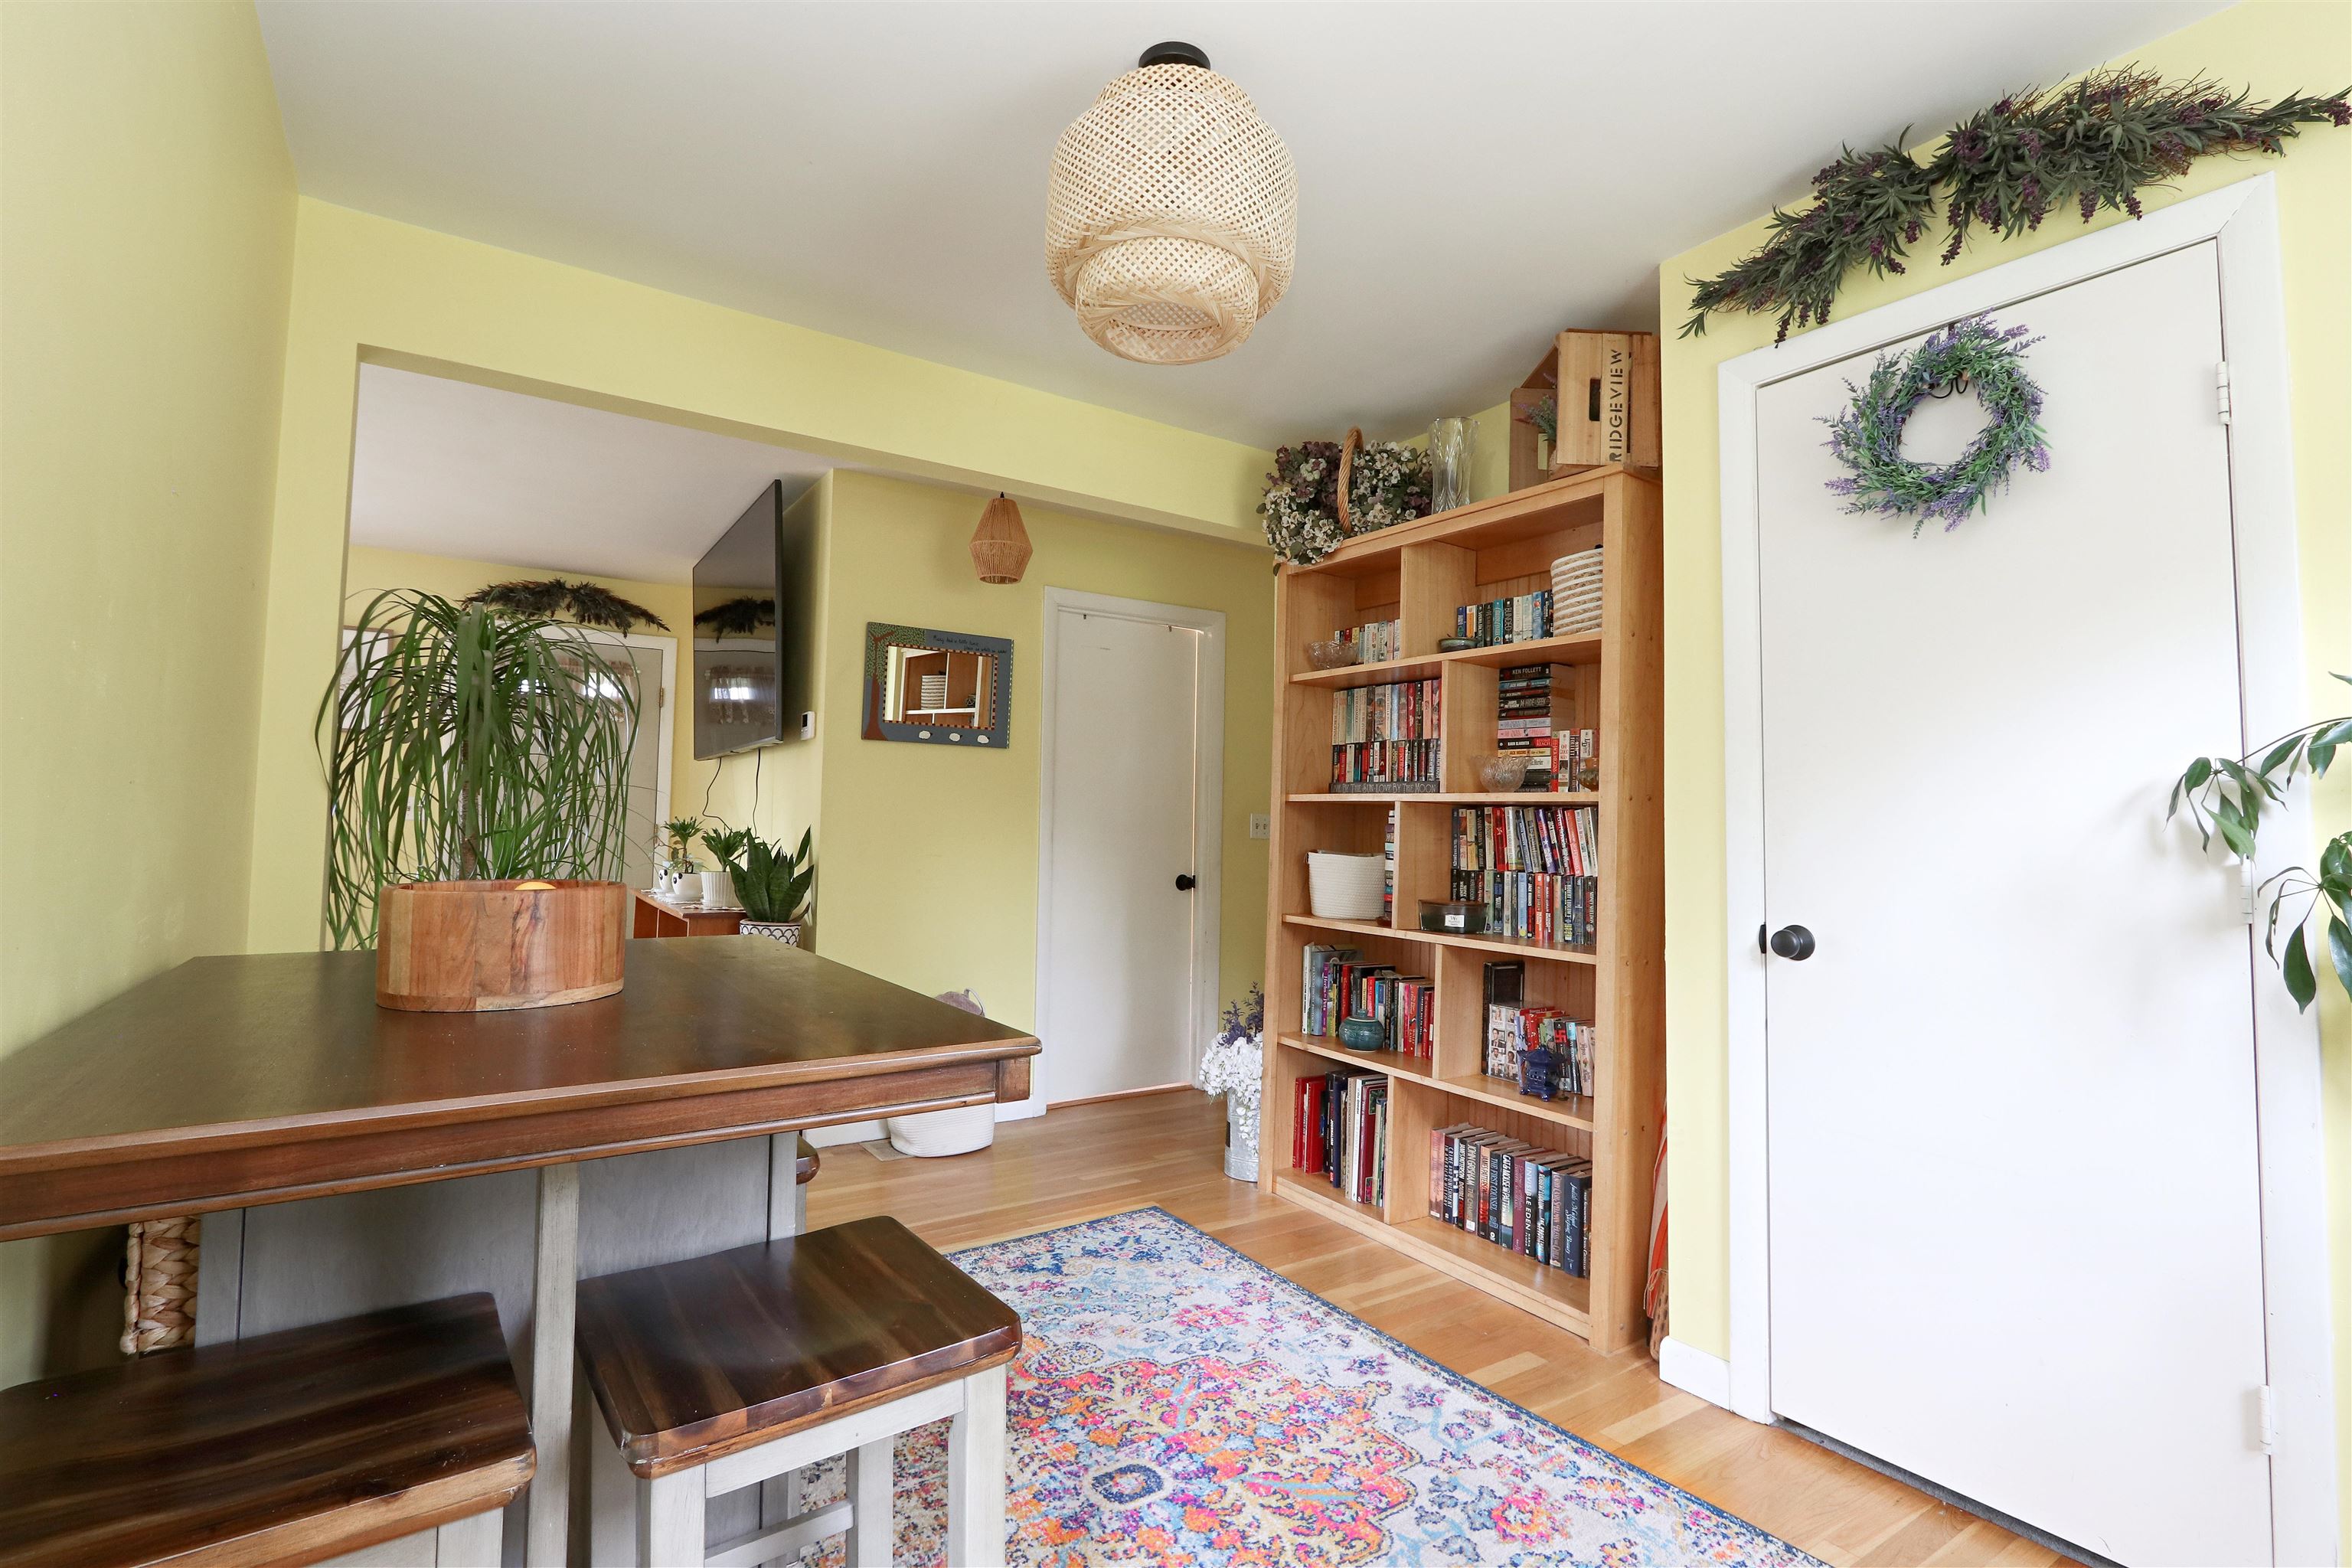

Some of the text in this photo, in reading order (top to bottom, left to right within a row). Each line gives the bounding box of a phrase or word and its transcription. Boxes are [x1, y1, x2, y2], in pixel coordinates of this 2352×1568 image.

[1609, 349, 1622, 462] RIDGEVIEW
[1393, 782, 1401, 792] BY
[1403, 782, 1414, 792] THE
[1415, 782, 1436, 792] MOON
[1467, 1144, 1476, 1161] JOHN
[1467, 1160, 1475, 1186] GRISHAM
[1553, 1201, 1562, 1223] SPELLMAN
